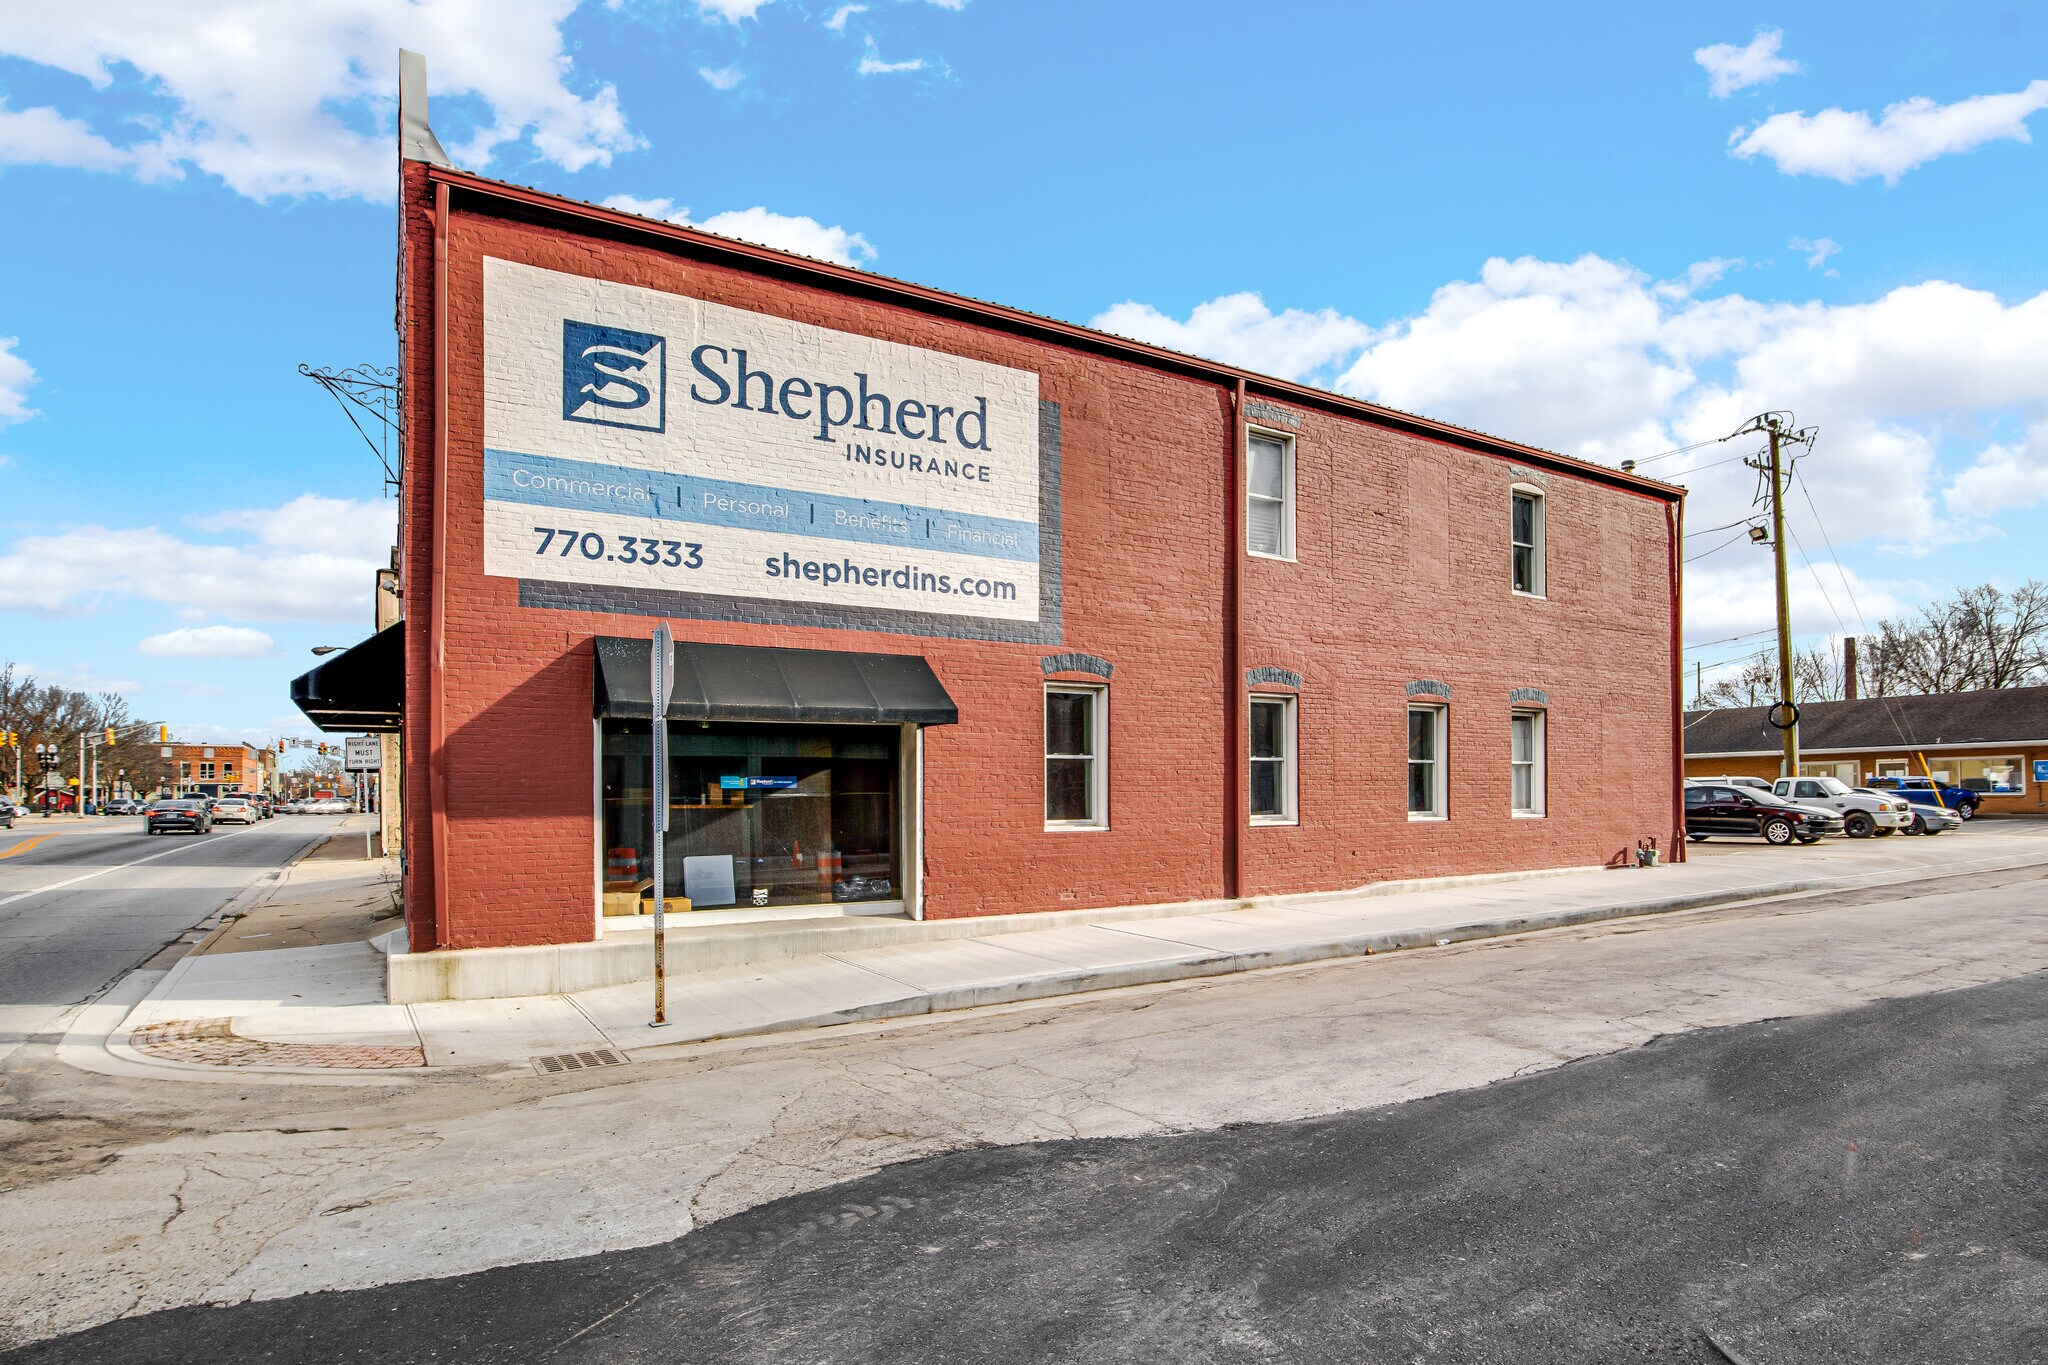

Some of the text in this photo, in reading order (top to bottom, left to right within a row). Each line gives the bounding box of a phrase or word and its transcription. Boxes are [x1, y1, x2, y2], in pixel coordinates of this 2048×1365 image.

[690, 343, 992, 452] Shepherd
[846, 443, 991, 483] INSURANCE
[512, 469, 1018, 548] Commercial Personal Benefits Financial
[534, 526, 704, 570] 770.3333
[765, 551, 1016, 601] shepherdins.com
